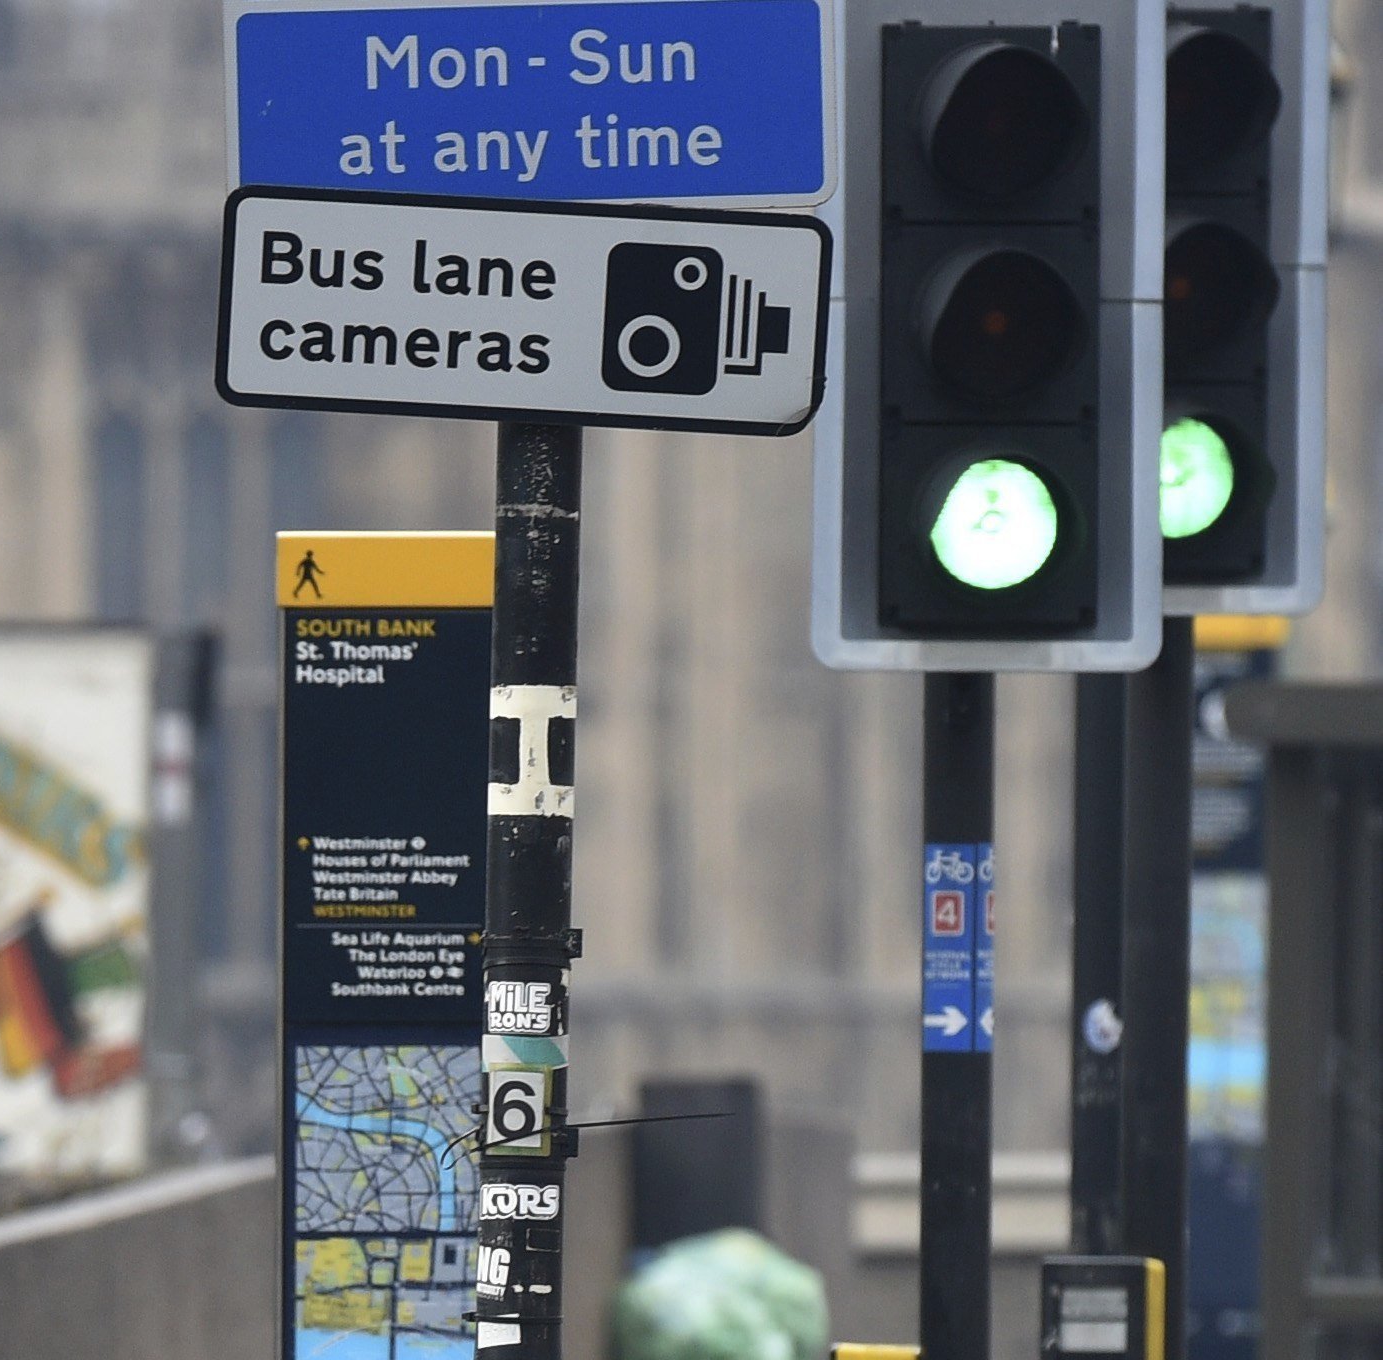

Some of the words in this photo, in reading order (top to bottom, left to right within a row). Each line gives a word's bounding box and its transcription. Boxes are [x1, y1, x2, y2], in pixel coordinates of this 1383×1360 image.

[365, 34, 508, 90] Mon
[569, 28, 697, 85] Sun
[339, 120, 406, 176] at
[434, 127, 549, 183] any
[575, 113, 723, 169] time
[260, 230, 385, 291] Bus
[413, 239, 557, 301] lane
[259, 319, 551, 375] cameras
[296, 618, 371, 637] SOUTH
[377, 618, 436, 637] BANK
[296, 641, 325, 661] St.
[330, 641, 419, 661] Thomas'
[296, 664, 385, 687] Hospital
[312, 837, 407, 850] Westminster
[312, 854, 368, 867] Houses
[370, 854, 388, 867] of
[390, 854, 471, 867] Parliament
[312, 871, 407, 884] Westminster
[410, 871, 458, 887] Abbey
[313, 887, 346, 900] Tate
[349, 887, 399, 900] Britain
[313, 904, 416, 918] WESTMINSTER
[937, 899, 956, 925] 4
[331, 932, 359, 945] Sea
[361, 932, 390, 945] Life
[393, 932, 465, 947] Aquarium
[348, 949, 377, 962] The
[379, 949, 435, 962] London
[438, 949, 465, 964] Eye
[357, 966, 427, 979] Waterloo
[331, 982, 410, 996] Southbank
[413, 982, 465, 996] Centre
[493, 1080, 536, 1139] 6
